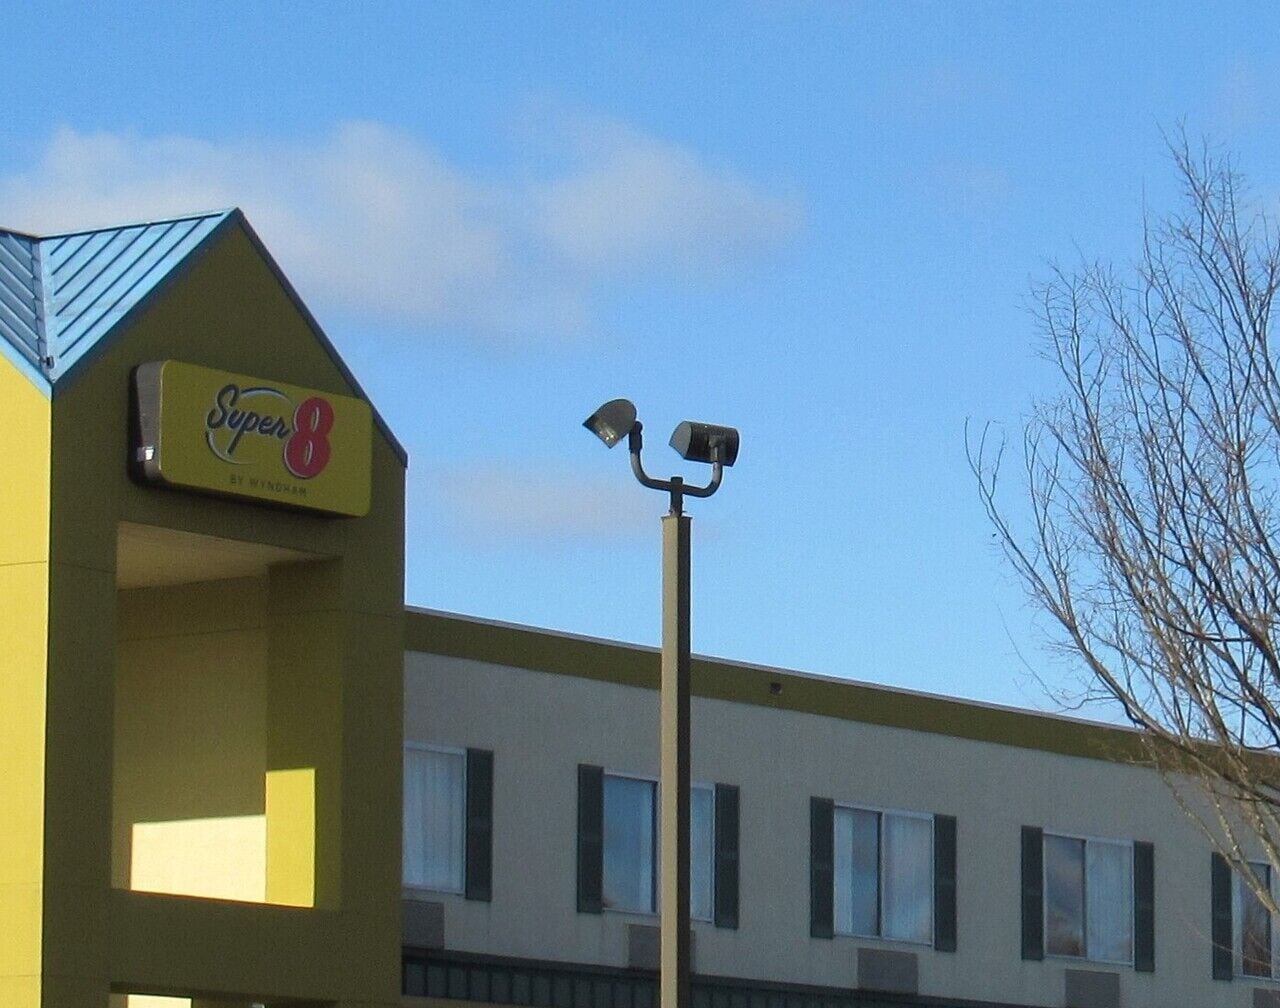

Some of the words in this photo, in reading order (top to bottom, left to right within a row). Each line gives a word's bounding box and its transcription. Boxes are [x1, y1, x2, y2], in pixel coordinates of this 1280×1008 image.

[206, 384, 290, 456] Super
[283, 396, 334, 480] 8
[229, 473, 244, 485] BY
[249, 475, 308, 497] WYNDHAM
